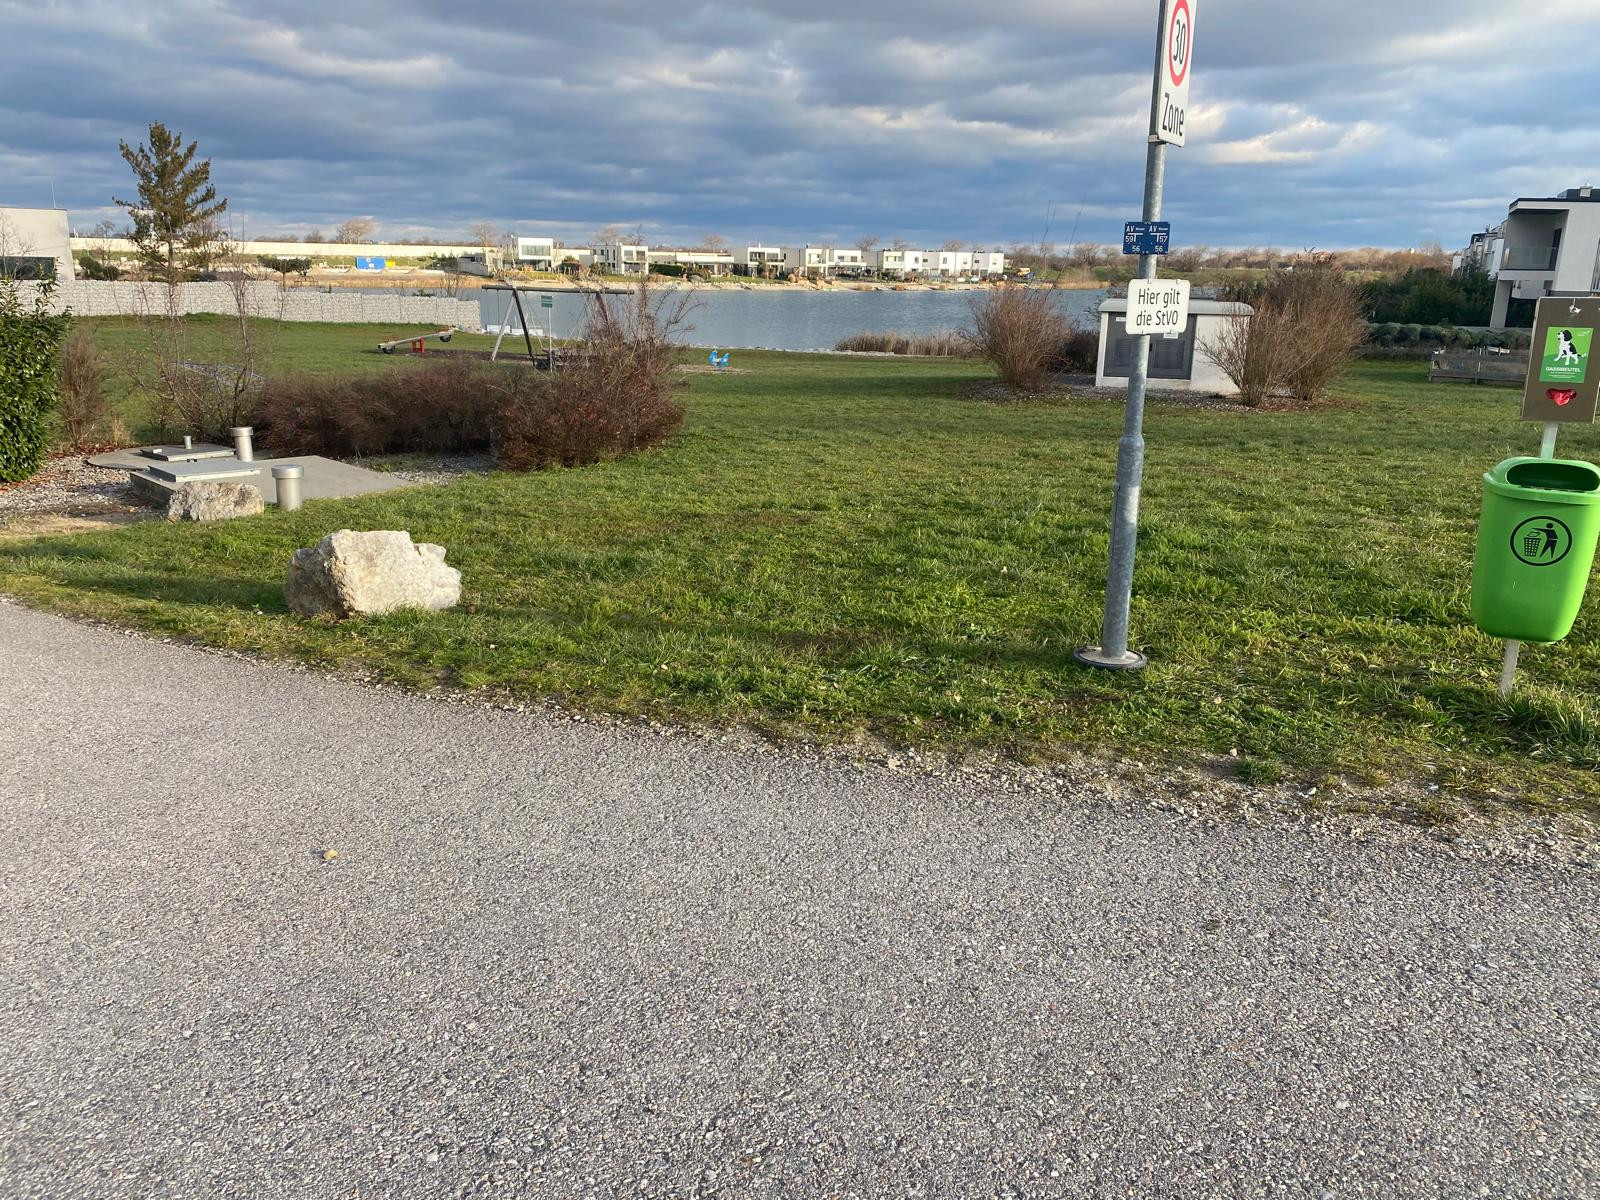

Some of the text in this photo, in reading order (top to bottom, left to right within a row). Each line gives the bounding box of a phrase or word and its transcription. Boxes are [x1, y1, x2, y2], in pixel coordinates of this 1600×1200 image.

[1173, 19, 1186, 64] 30
[1162, 92, 1185, 137] Zone
[1126, 225, 1135, 233] AV
[1149, 225, 1158, 233] AV
[1138, 287, 1180, 308] Hier gilt
[1136, 309, 1179, 326] die StVO
